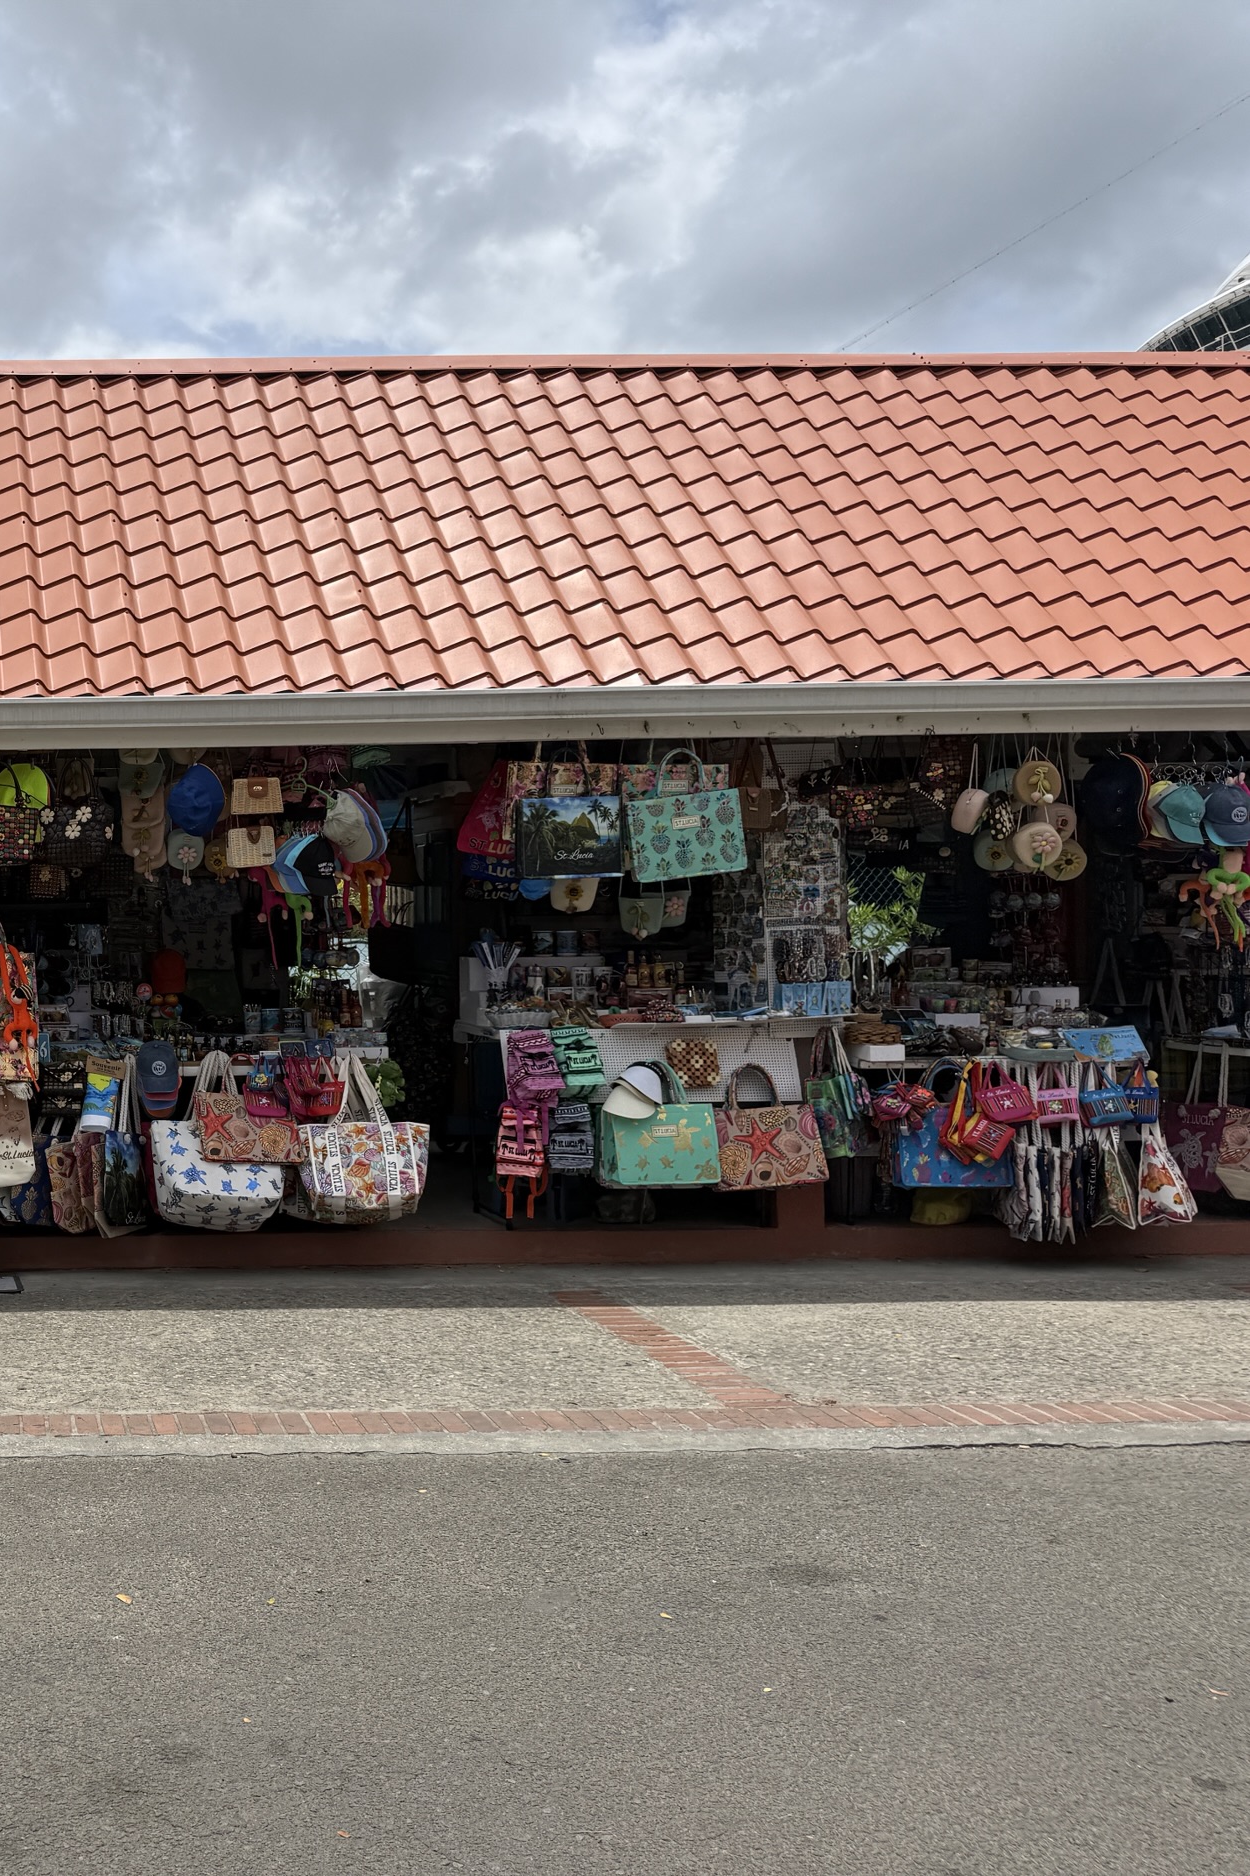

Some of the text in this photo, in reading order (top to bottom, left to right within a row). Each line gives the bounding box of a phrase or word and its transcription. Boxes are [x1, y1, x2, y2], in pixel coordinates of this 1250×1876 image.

[488, 841, 516, 855] LUC
[488, 864, 516, 878] LUC
[91, 1060, 121, 1071] Souvenir
